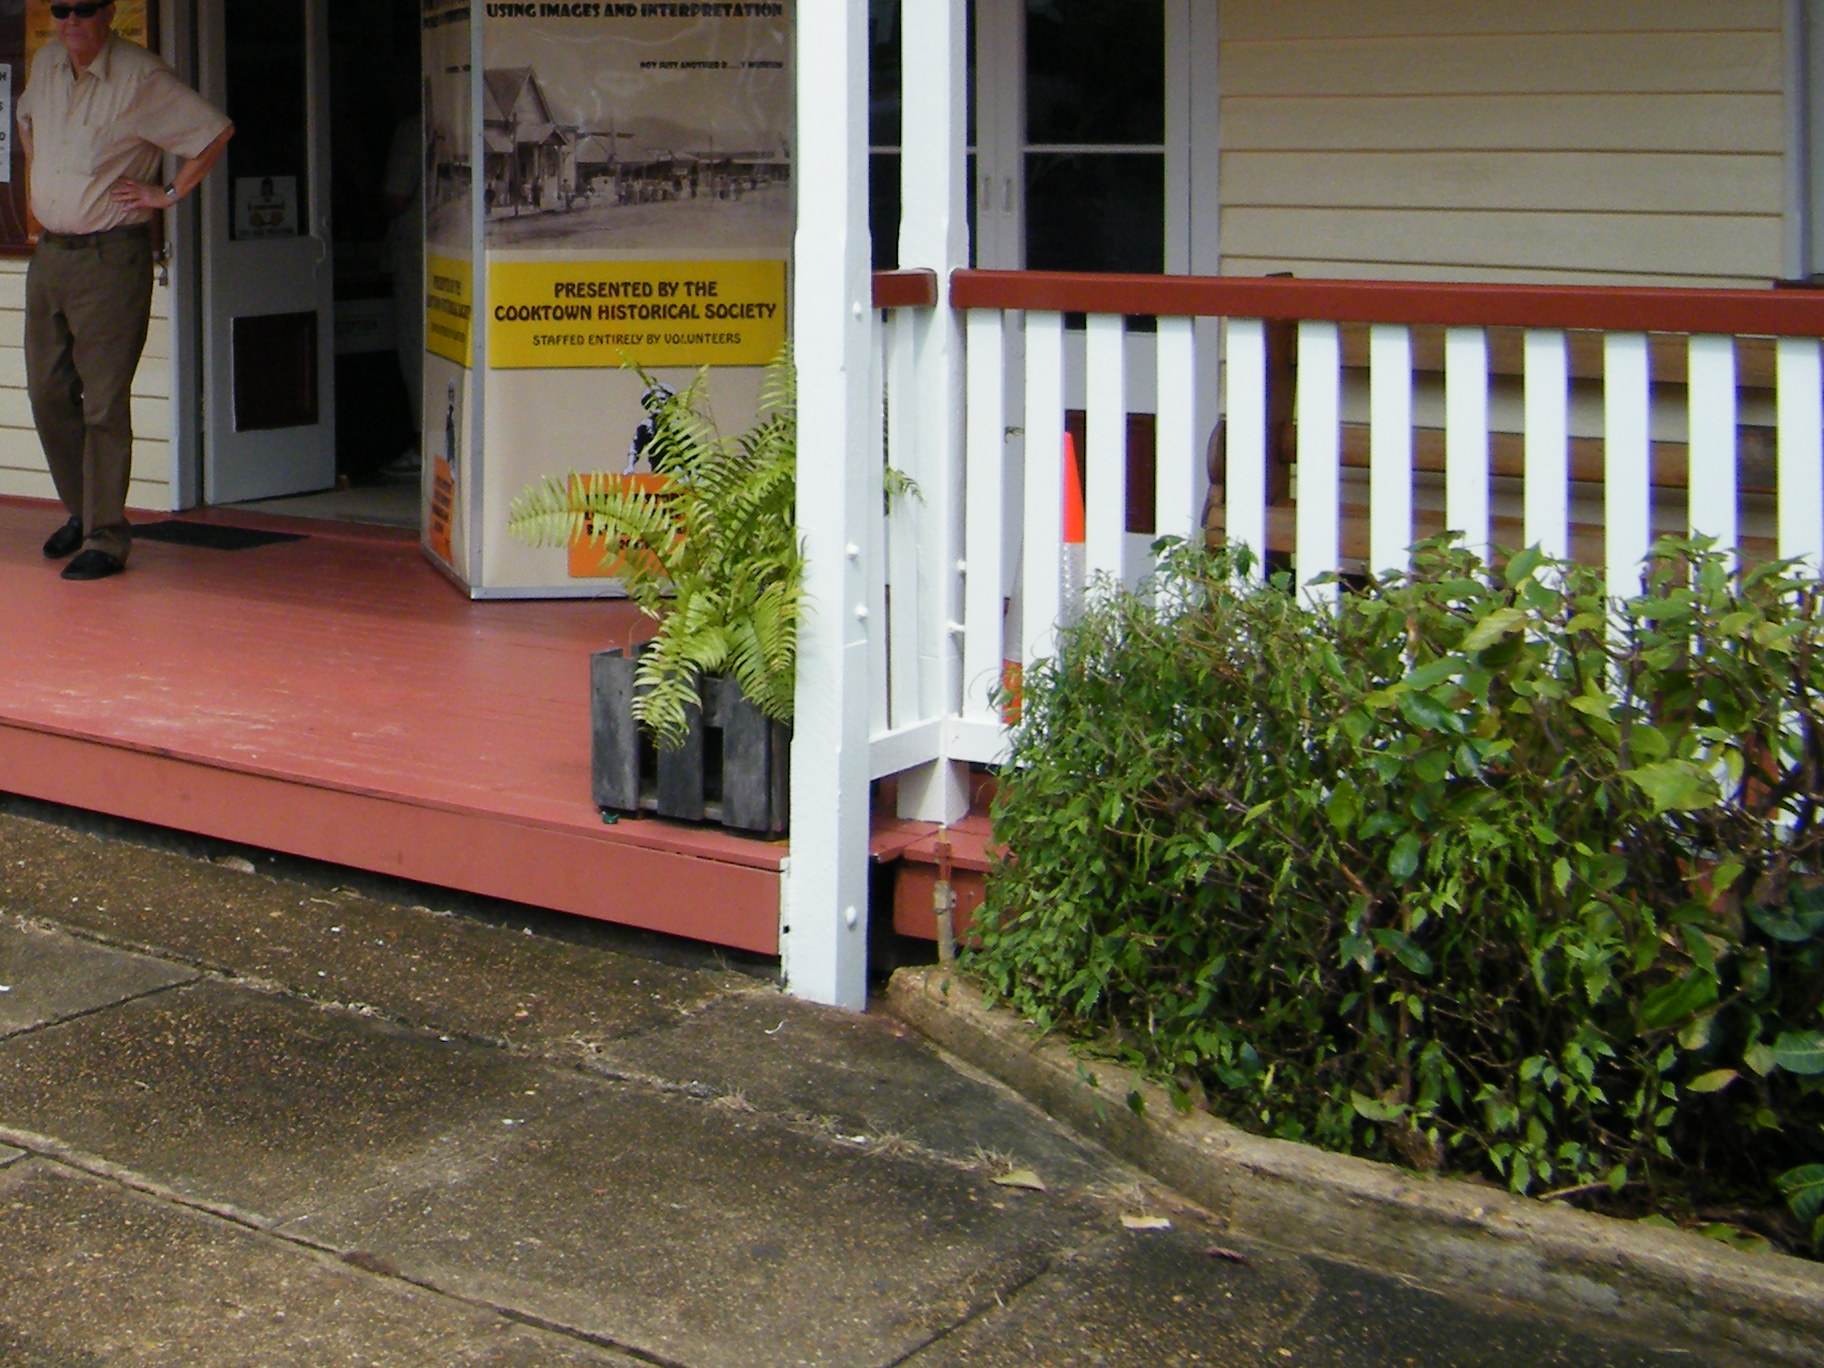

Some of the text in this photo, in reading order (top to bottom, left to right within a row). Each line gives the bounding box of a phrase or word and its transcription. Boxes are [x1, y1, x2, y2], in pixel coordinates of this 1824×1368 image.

[486, 3, 782, 17] USING IMAGES AND INTERPRETATION
[554, 281, 718, 298] PRESENTED BY THE
[494, 303, 776, 321] COOKTOWN HISTORICAL SOCIETY
[533, 333, 741, 346] STAFFED ENTIRELY BY VOLUNTEERS
